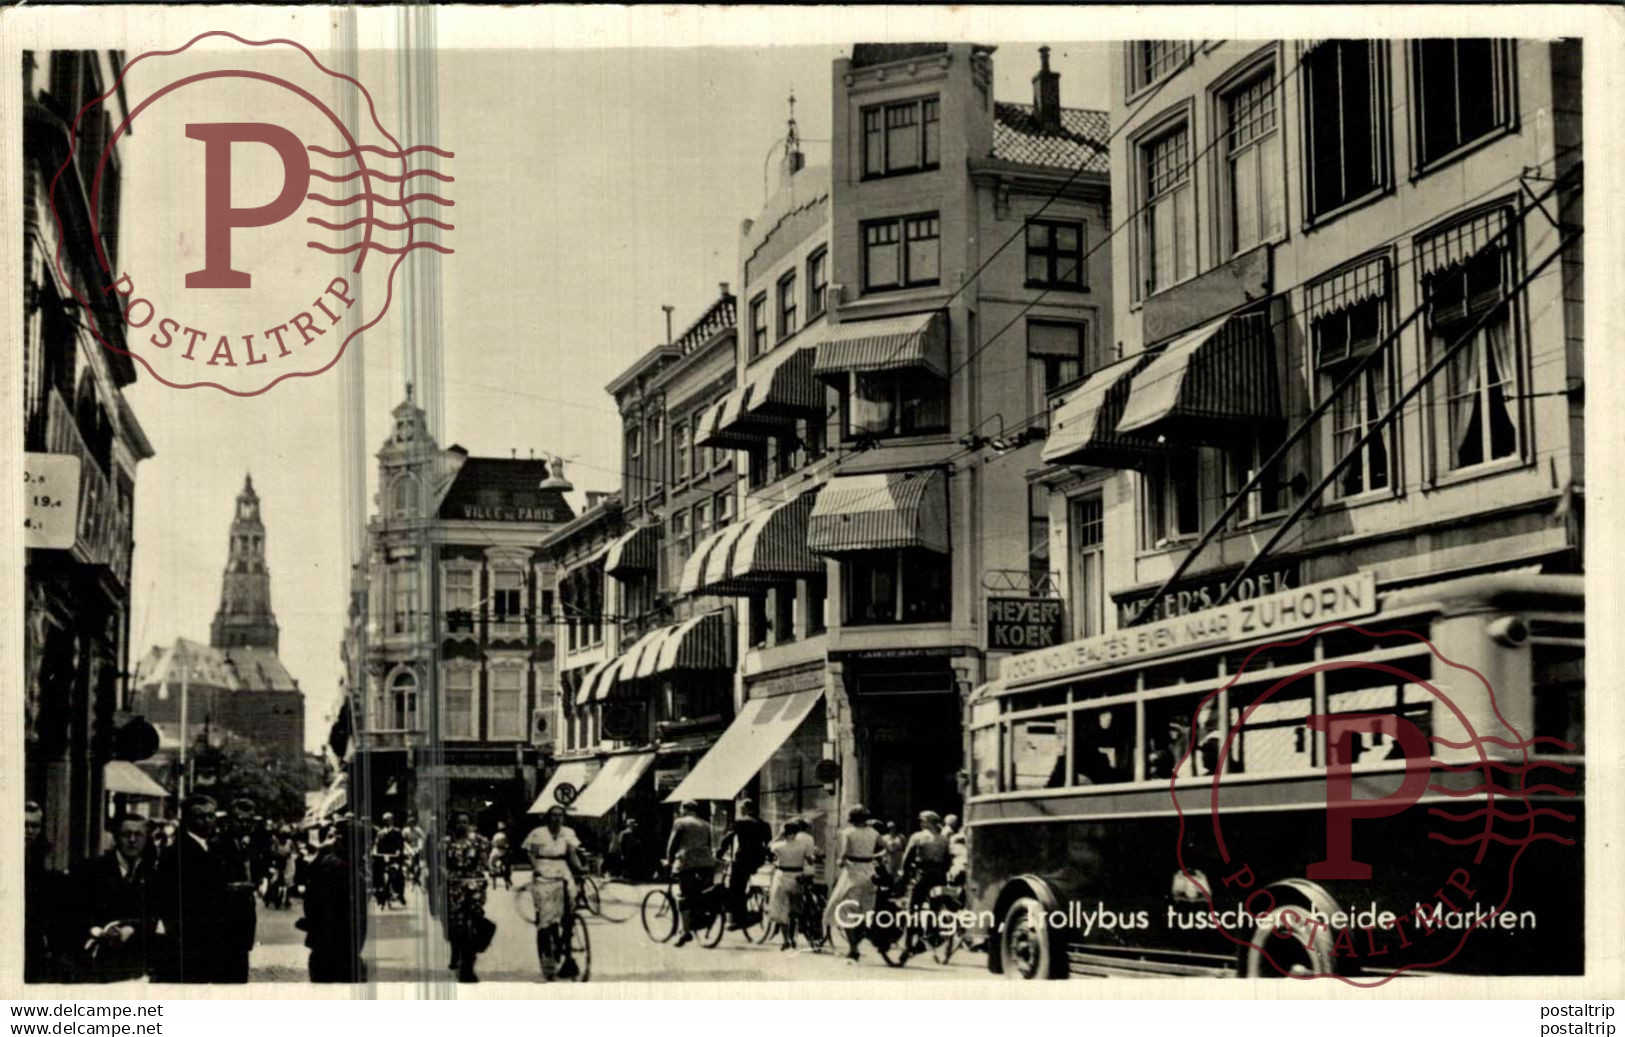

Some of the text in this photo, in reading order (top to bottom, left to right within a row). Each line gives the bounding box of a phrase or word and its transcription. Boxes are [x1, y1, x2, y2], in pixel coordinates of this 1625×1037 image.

[464, 504, 503, 520] VILLE
[518, 507, 555, 521] PARIS
[1240, 580, 1363, 634] ZUHORN
[994, 624, 1054, 647] KOEK
